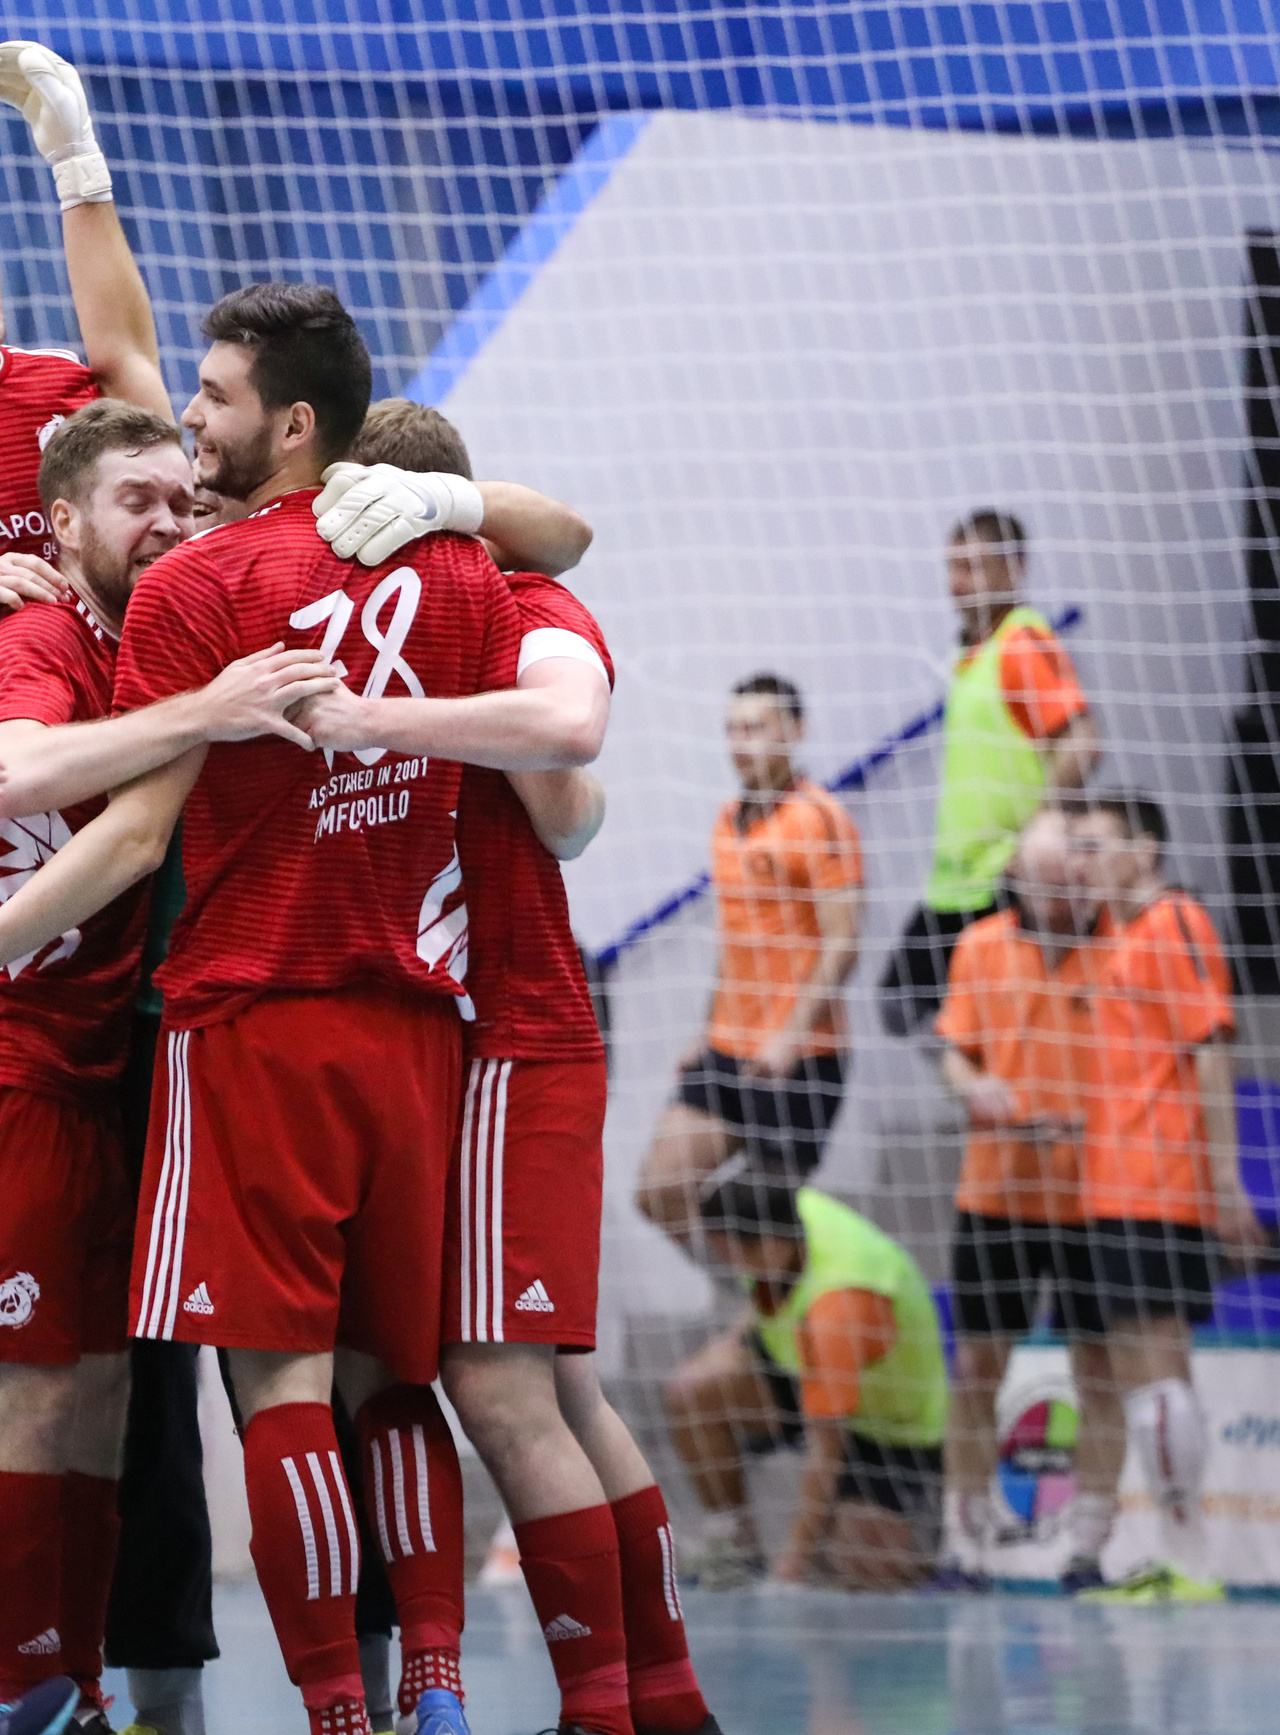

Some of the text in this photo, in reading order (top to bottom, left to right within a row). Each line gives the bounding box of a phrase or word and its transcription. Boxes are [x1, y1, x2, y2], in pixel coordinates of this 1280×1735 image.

[376, 765, 392, 786] IN
[393, 756, 428, 783] 2001
[183, 1300, 215, 1315] adidas
[514, 1299, 555, 1313] adidas
